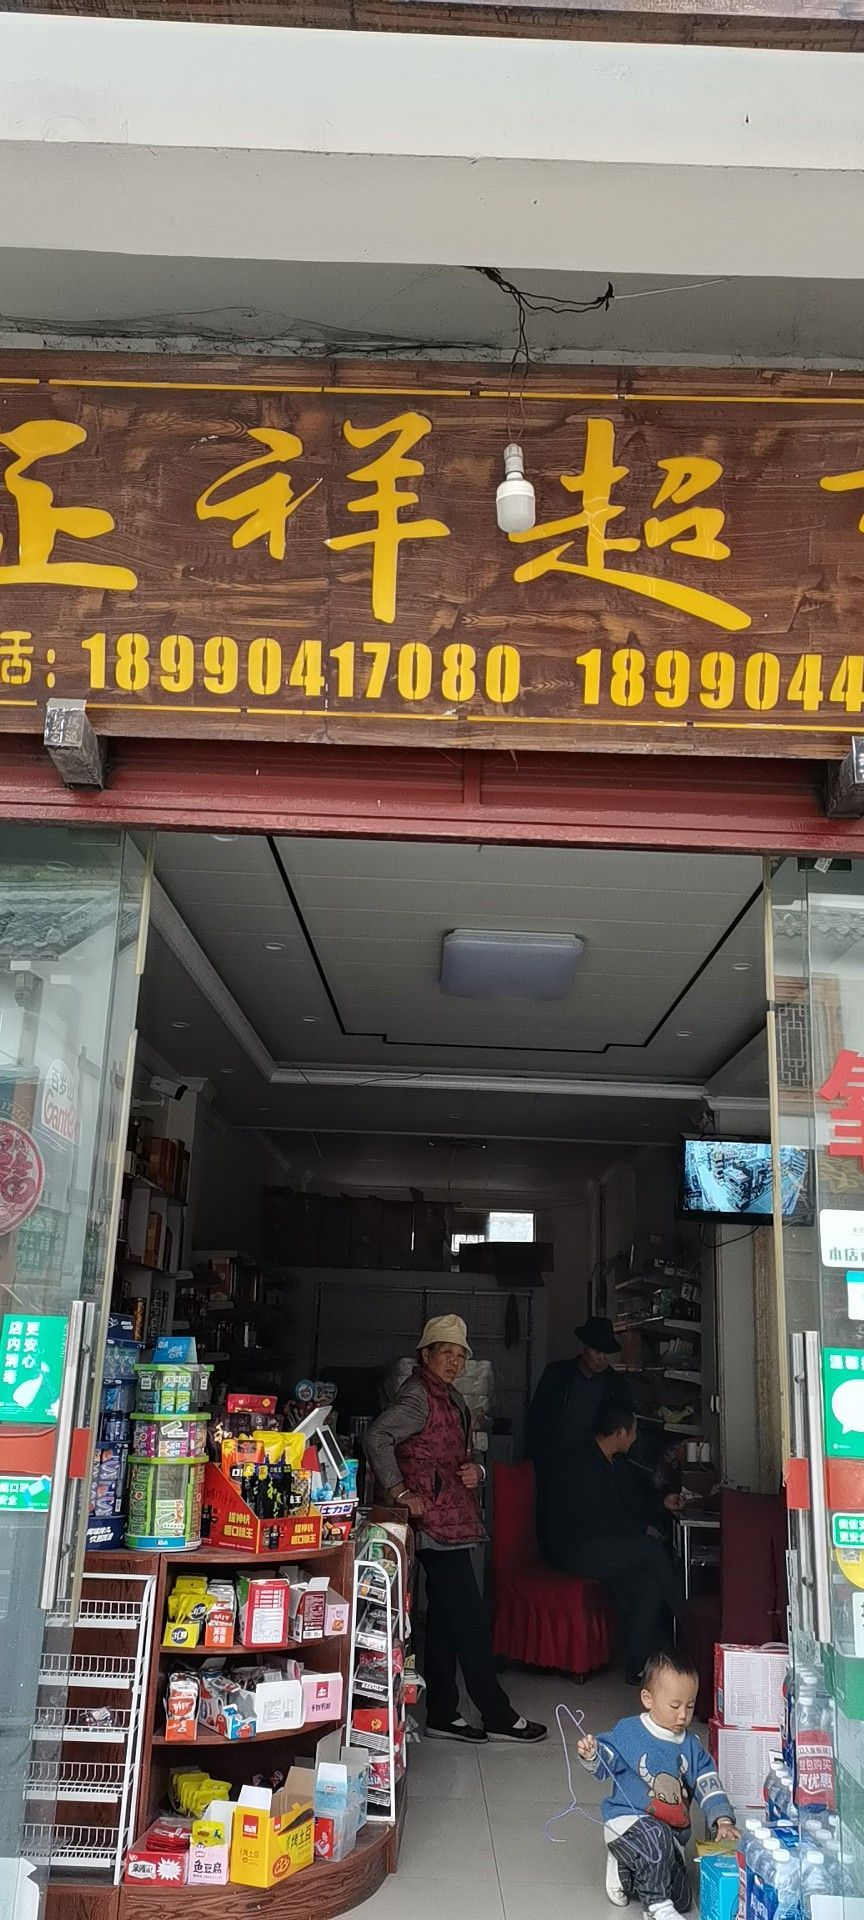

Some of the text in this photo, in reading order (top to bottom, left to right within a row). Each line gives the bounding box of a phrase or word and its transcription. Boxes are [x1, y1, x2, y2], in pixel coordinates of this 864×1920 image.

[576, 648, 864, 712] 1899044
[193, 1860, 222, 1875] 鱼豆腐
